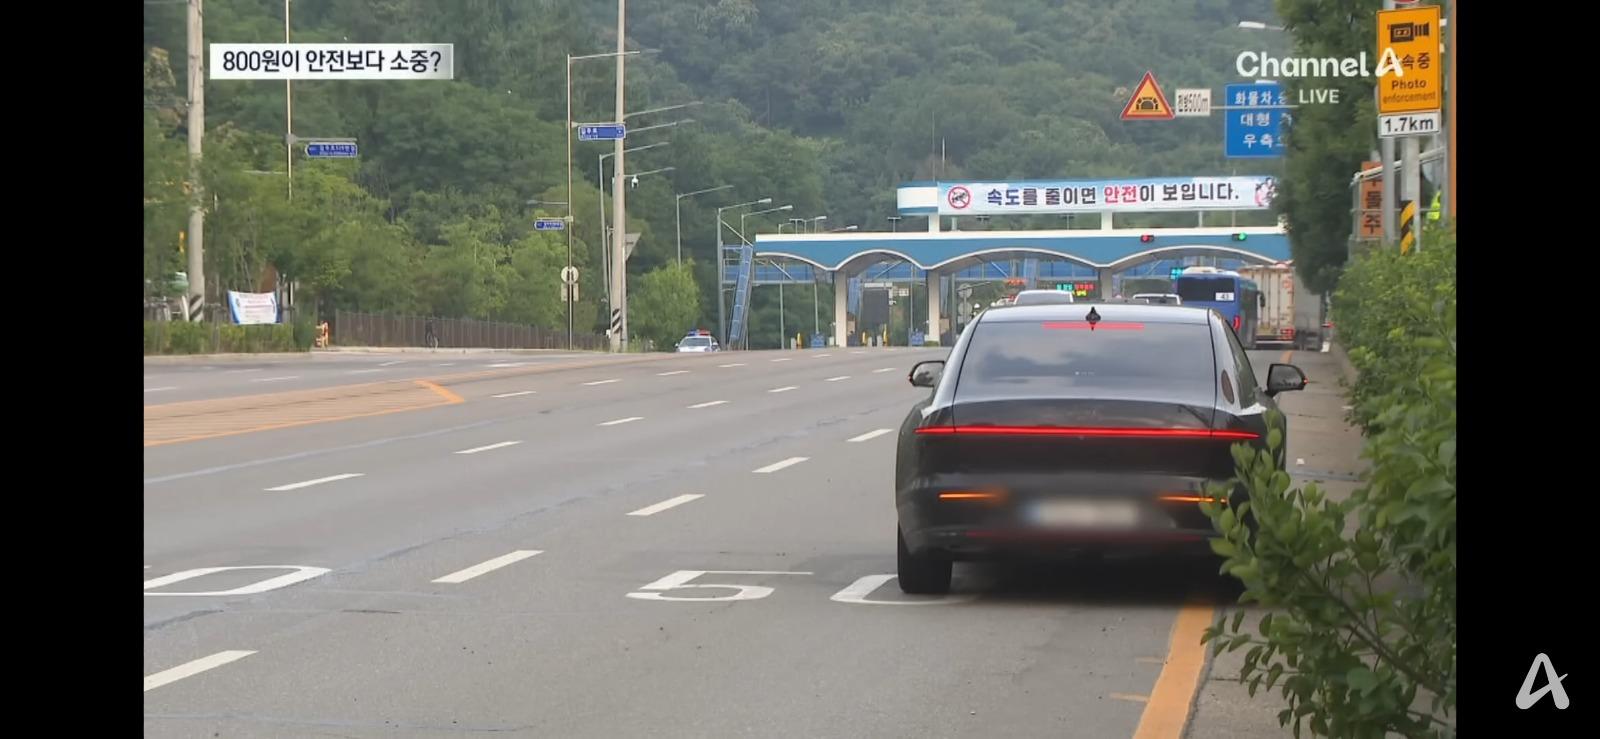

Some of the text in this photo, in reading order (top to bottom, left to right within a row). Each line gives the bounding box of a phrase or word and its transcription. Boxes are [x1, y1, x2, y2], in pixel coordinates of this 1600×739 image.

[1391, 79, 1427, 90] Photo
[1382, 91, 1436, 104] enforcement
[1385, 117, 1434, 132] 1.7km
[988, 183, 1239, 206] 속도를 줄이면 안전이 보입니다.
